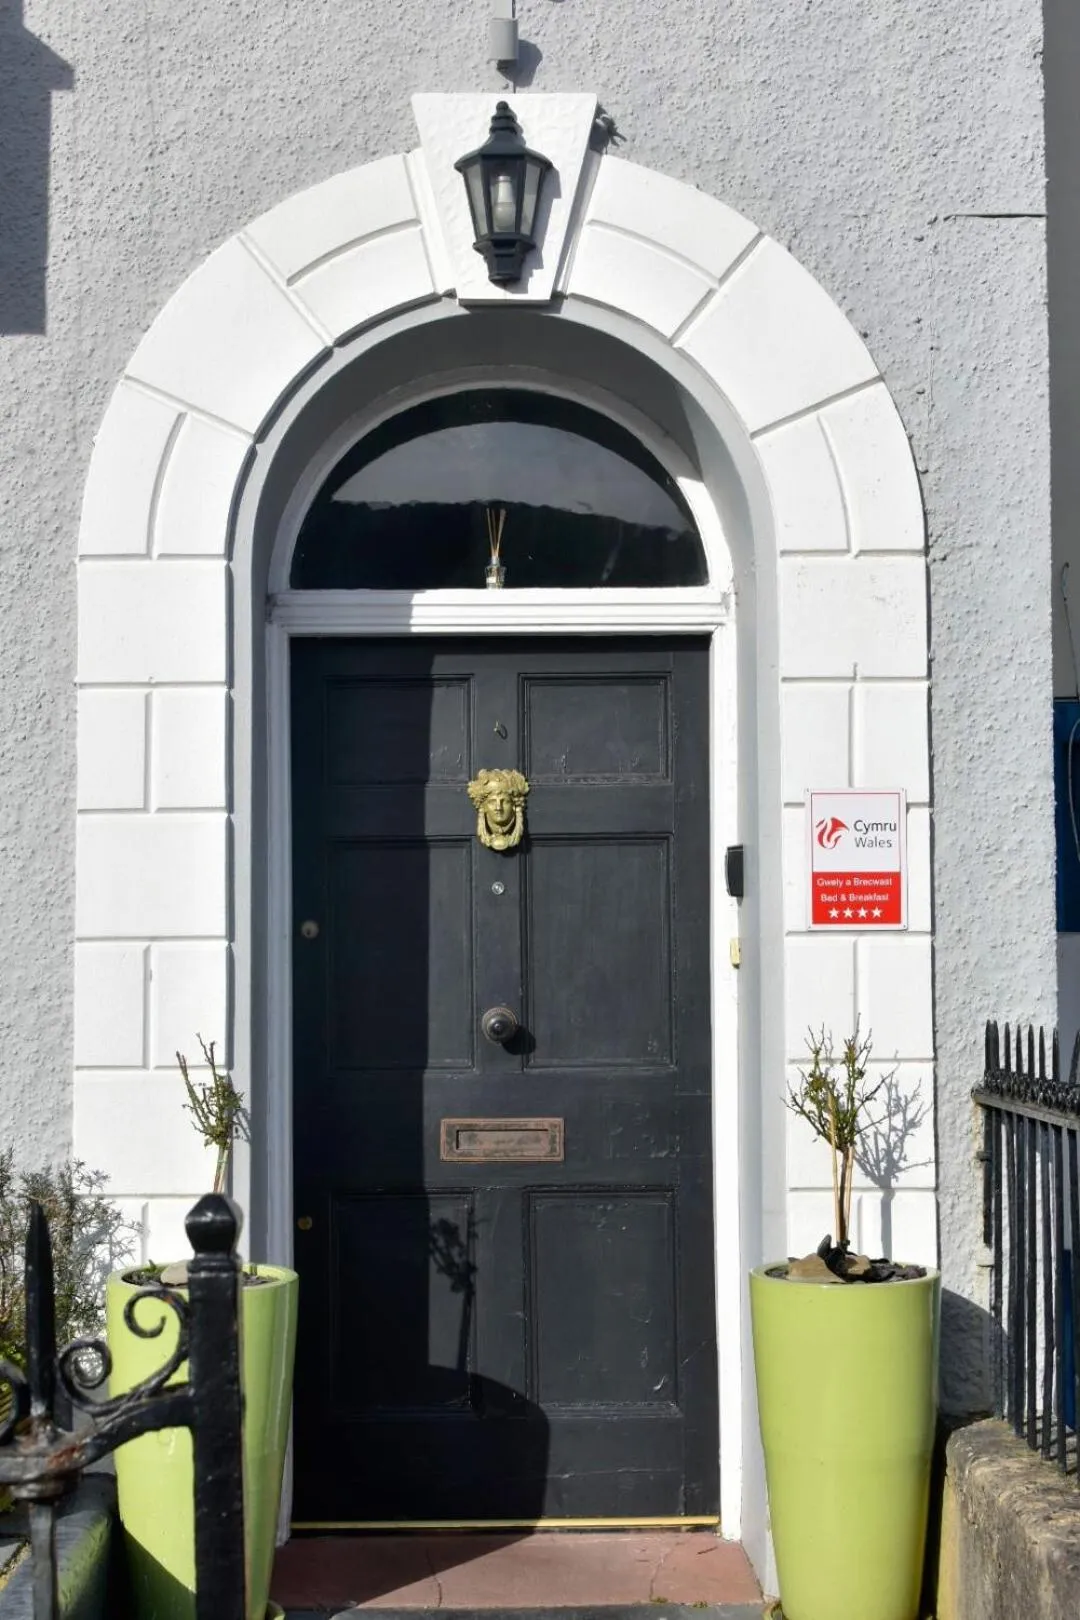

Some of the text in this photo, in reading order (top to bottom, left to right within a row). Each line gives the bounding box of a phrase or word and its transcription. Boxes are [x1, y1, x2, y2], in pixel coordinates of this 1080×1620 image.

[853, 819, 897, 834] Cymru
[855, 837, 893, 848] Wales
[821, 893, 889, 902] Bed & Breakfast
